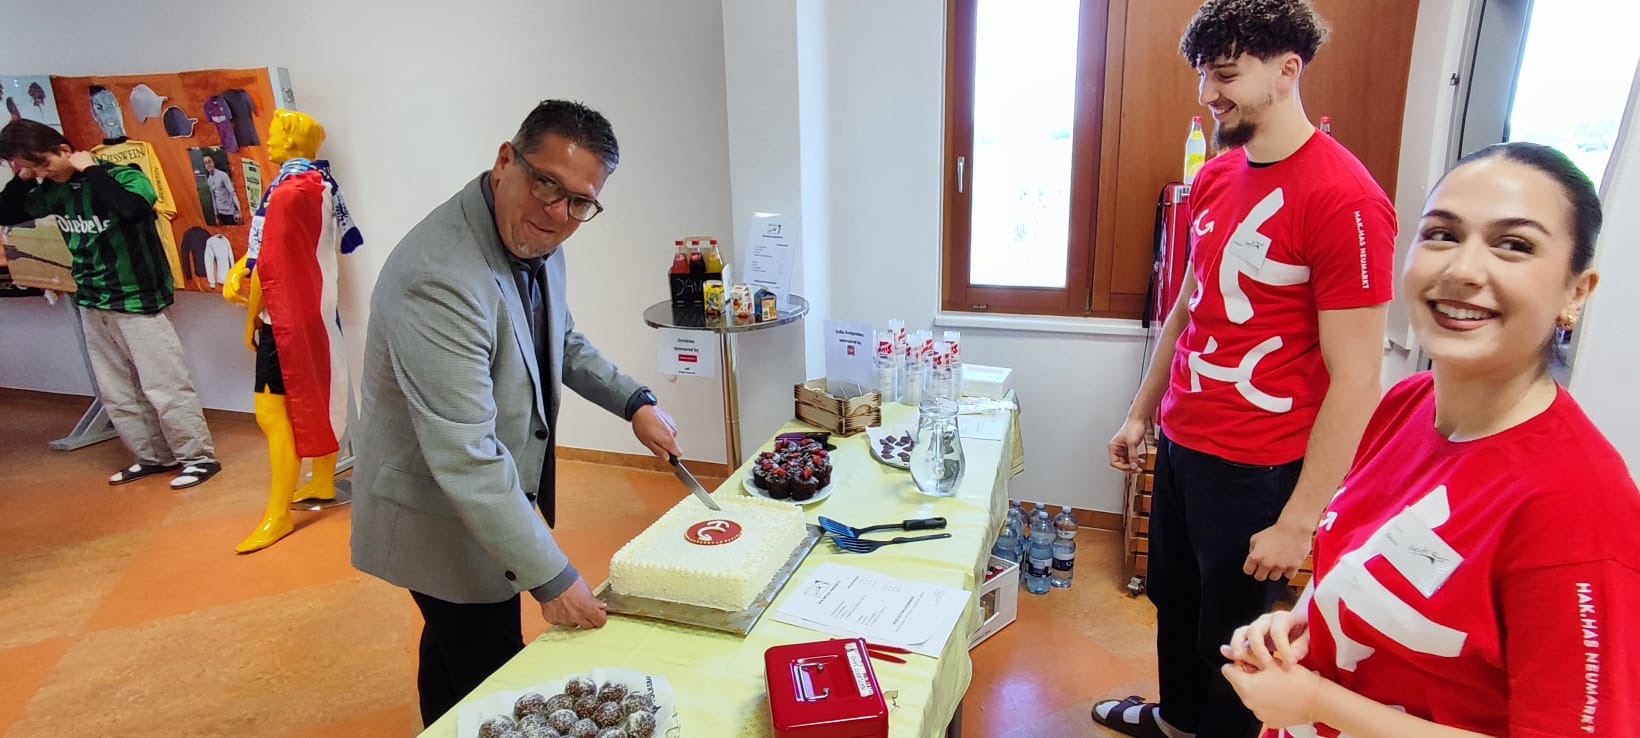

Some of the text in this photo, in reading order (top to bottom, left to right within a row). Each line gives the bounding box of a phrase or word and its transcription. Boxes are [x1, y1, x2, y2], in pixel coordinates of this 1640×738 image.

[1354, 210, 1370, 289] HAK.HAS NEUMARKT
[1576, 582, 1600, 734] HAK.HAS NEUMARKT
